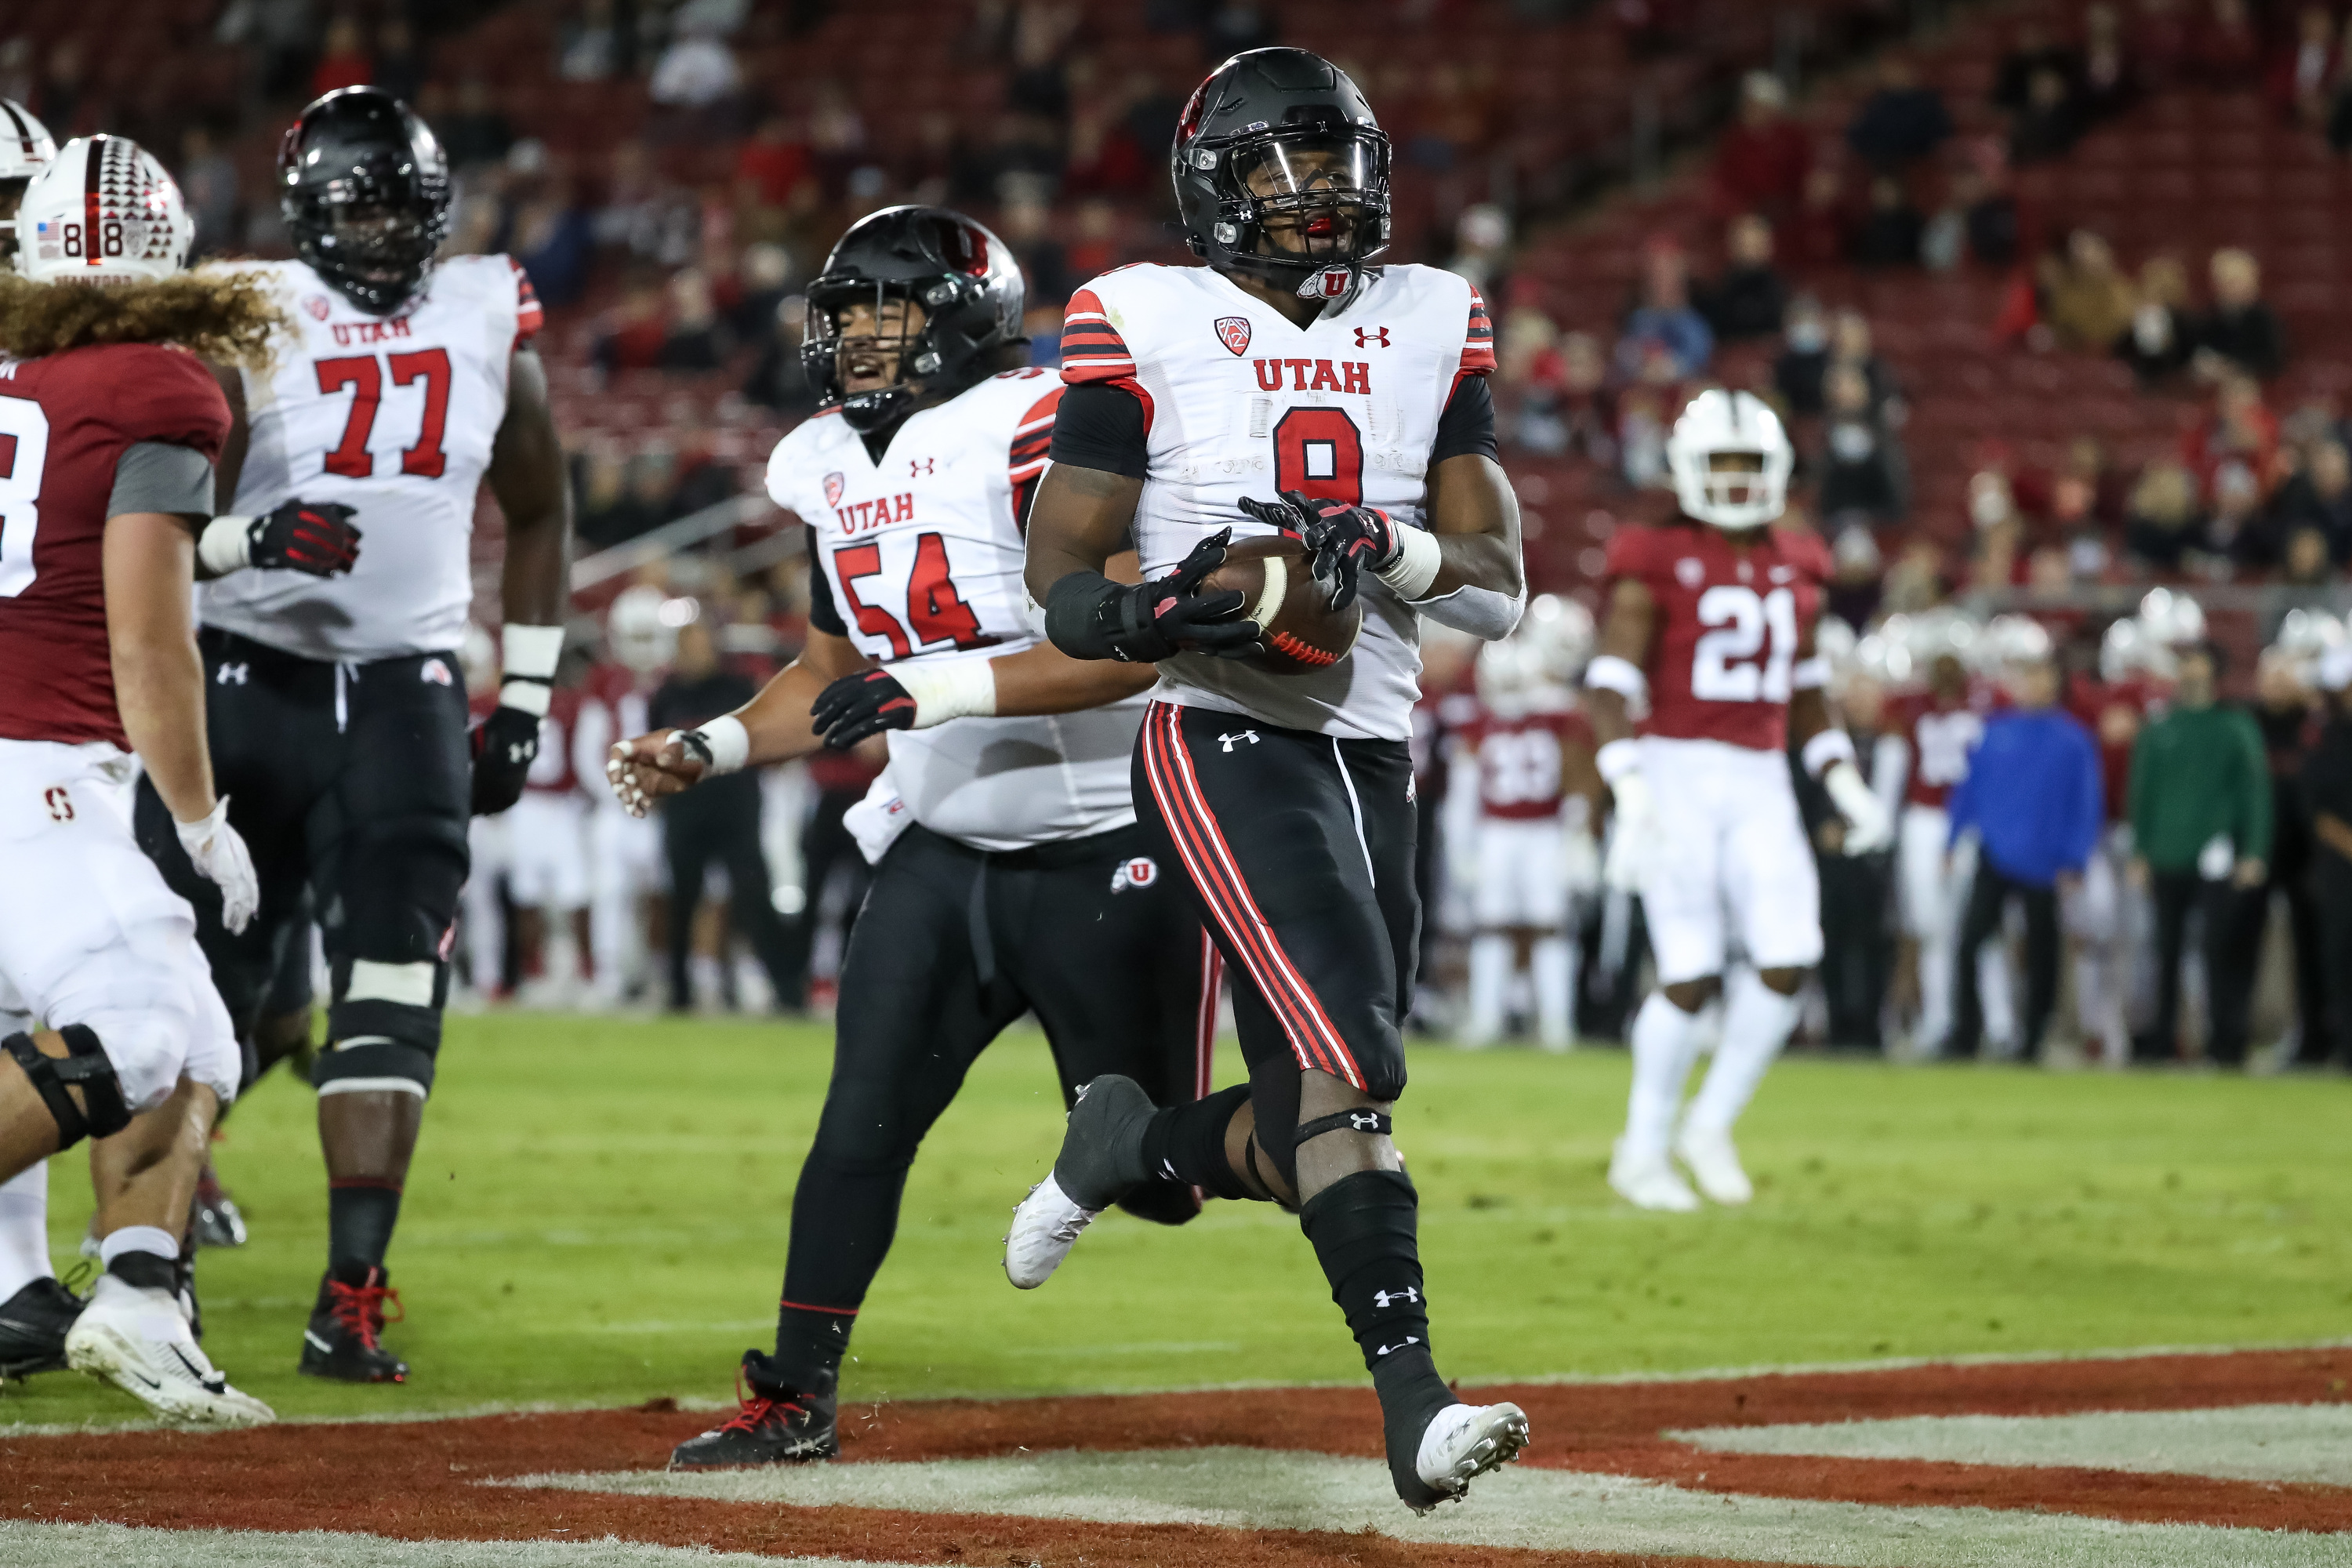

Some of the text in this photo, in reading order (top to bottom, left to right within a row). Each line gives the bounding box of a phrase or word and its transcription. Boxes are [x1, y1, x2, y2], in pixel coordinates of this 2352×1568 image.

[1325, 272, 1348, 296] U
[331, 316, 412, 347] UTAH
[1227, 332, 1247, 347] 12
[1252, 358, 1371, 395] UTAH
[313, 347, 452, 480] 77
[837, 492, 913, 535] UTAH
[833, 532, 1002, 663] 54
[1690, 585, 1798, 704] 21
[1131, 864, 1149, 881] U
